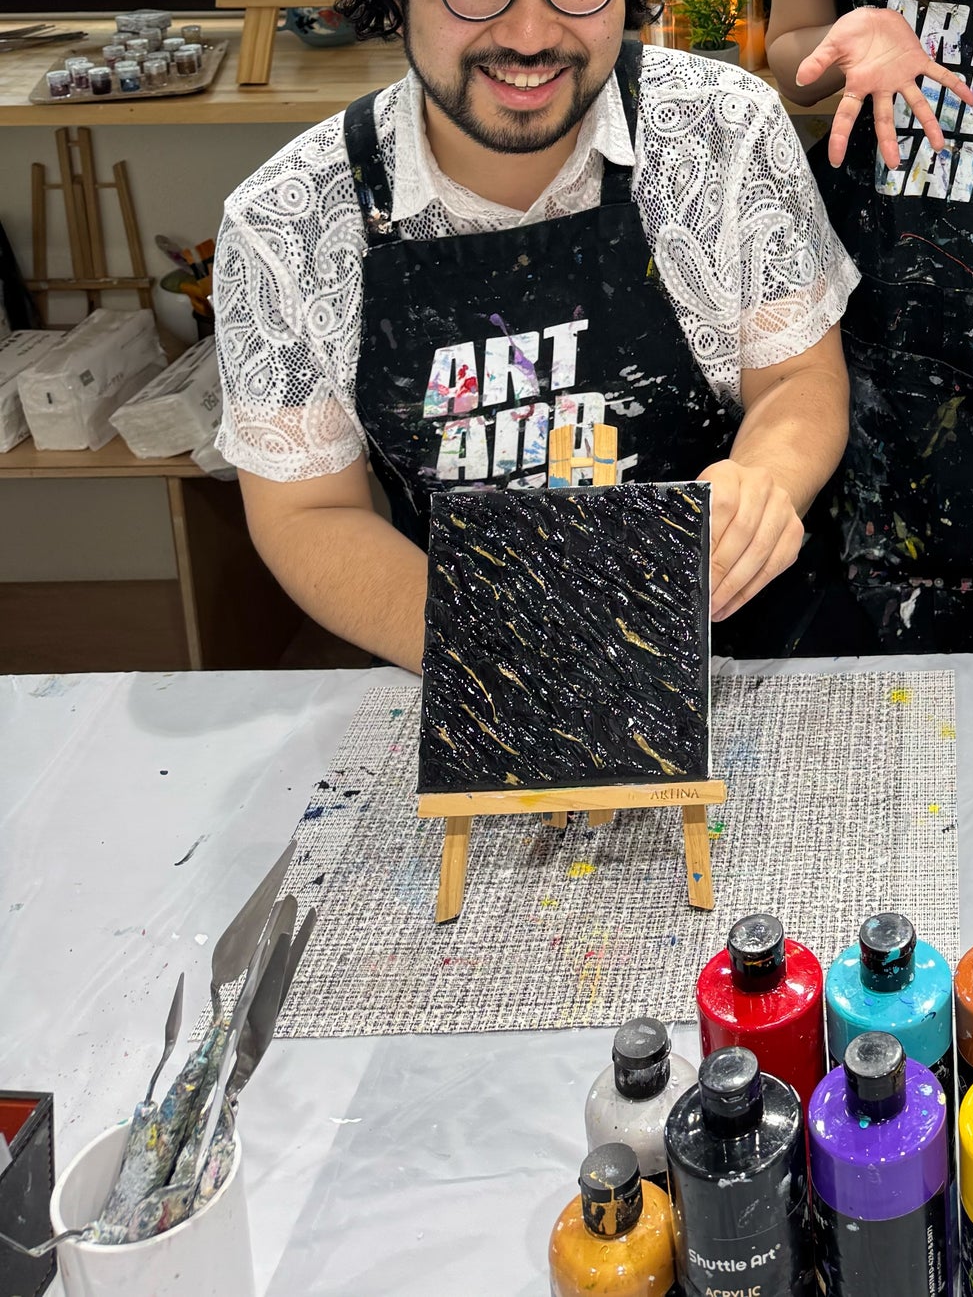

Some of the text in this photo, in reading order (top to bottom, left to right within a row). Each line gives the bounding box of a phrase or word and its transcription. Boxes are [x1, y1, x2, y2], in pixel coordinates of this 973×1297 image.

[423, 319, 589, 419] ART
[650, 788, 700, 800] ARTINA
[688, 1248, 777, 1273] Shuttle Art
[705, 1285, 761, 1297] ACRYLIC
